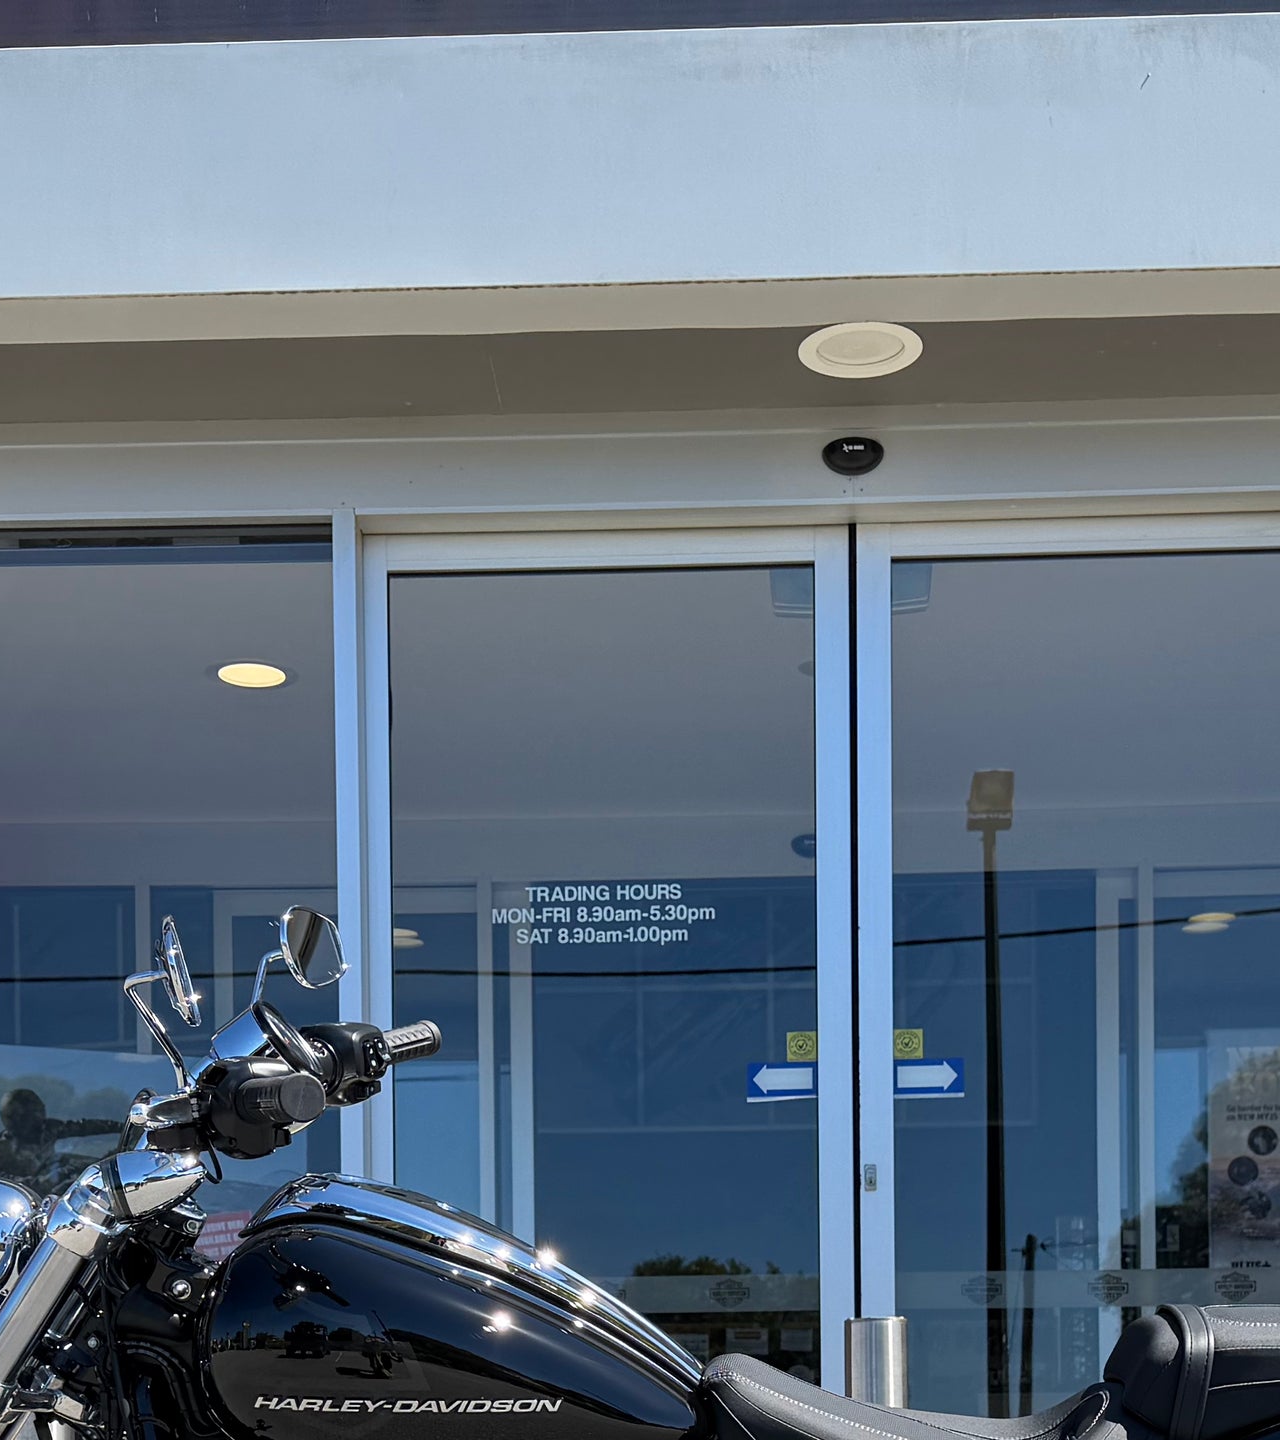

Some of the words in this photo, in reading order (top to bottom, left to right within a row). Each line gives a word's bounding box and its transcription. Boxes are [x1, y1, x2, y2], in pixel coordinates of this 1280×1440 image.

[525, 885, 610, 903] TRADING
[616, 883, 682, 901] HOURS
[491, 906, 571, 924] MON-FRI
[516, 928, 552, 944] SAT
[254, 1397, 563, 1413] HARLEY-DAVIDSON
